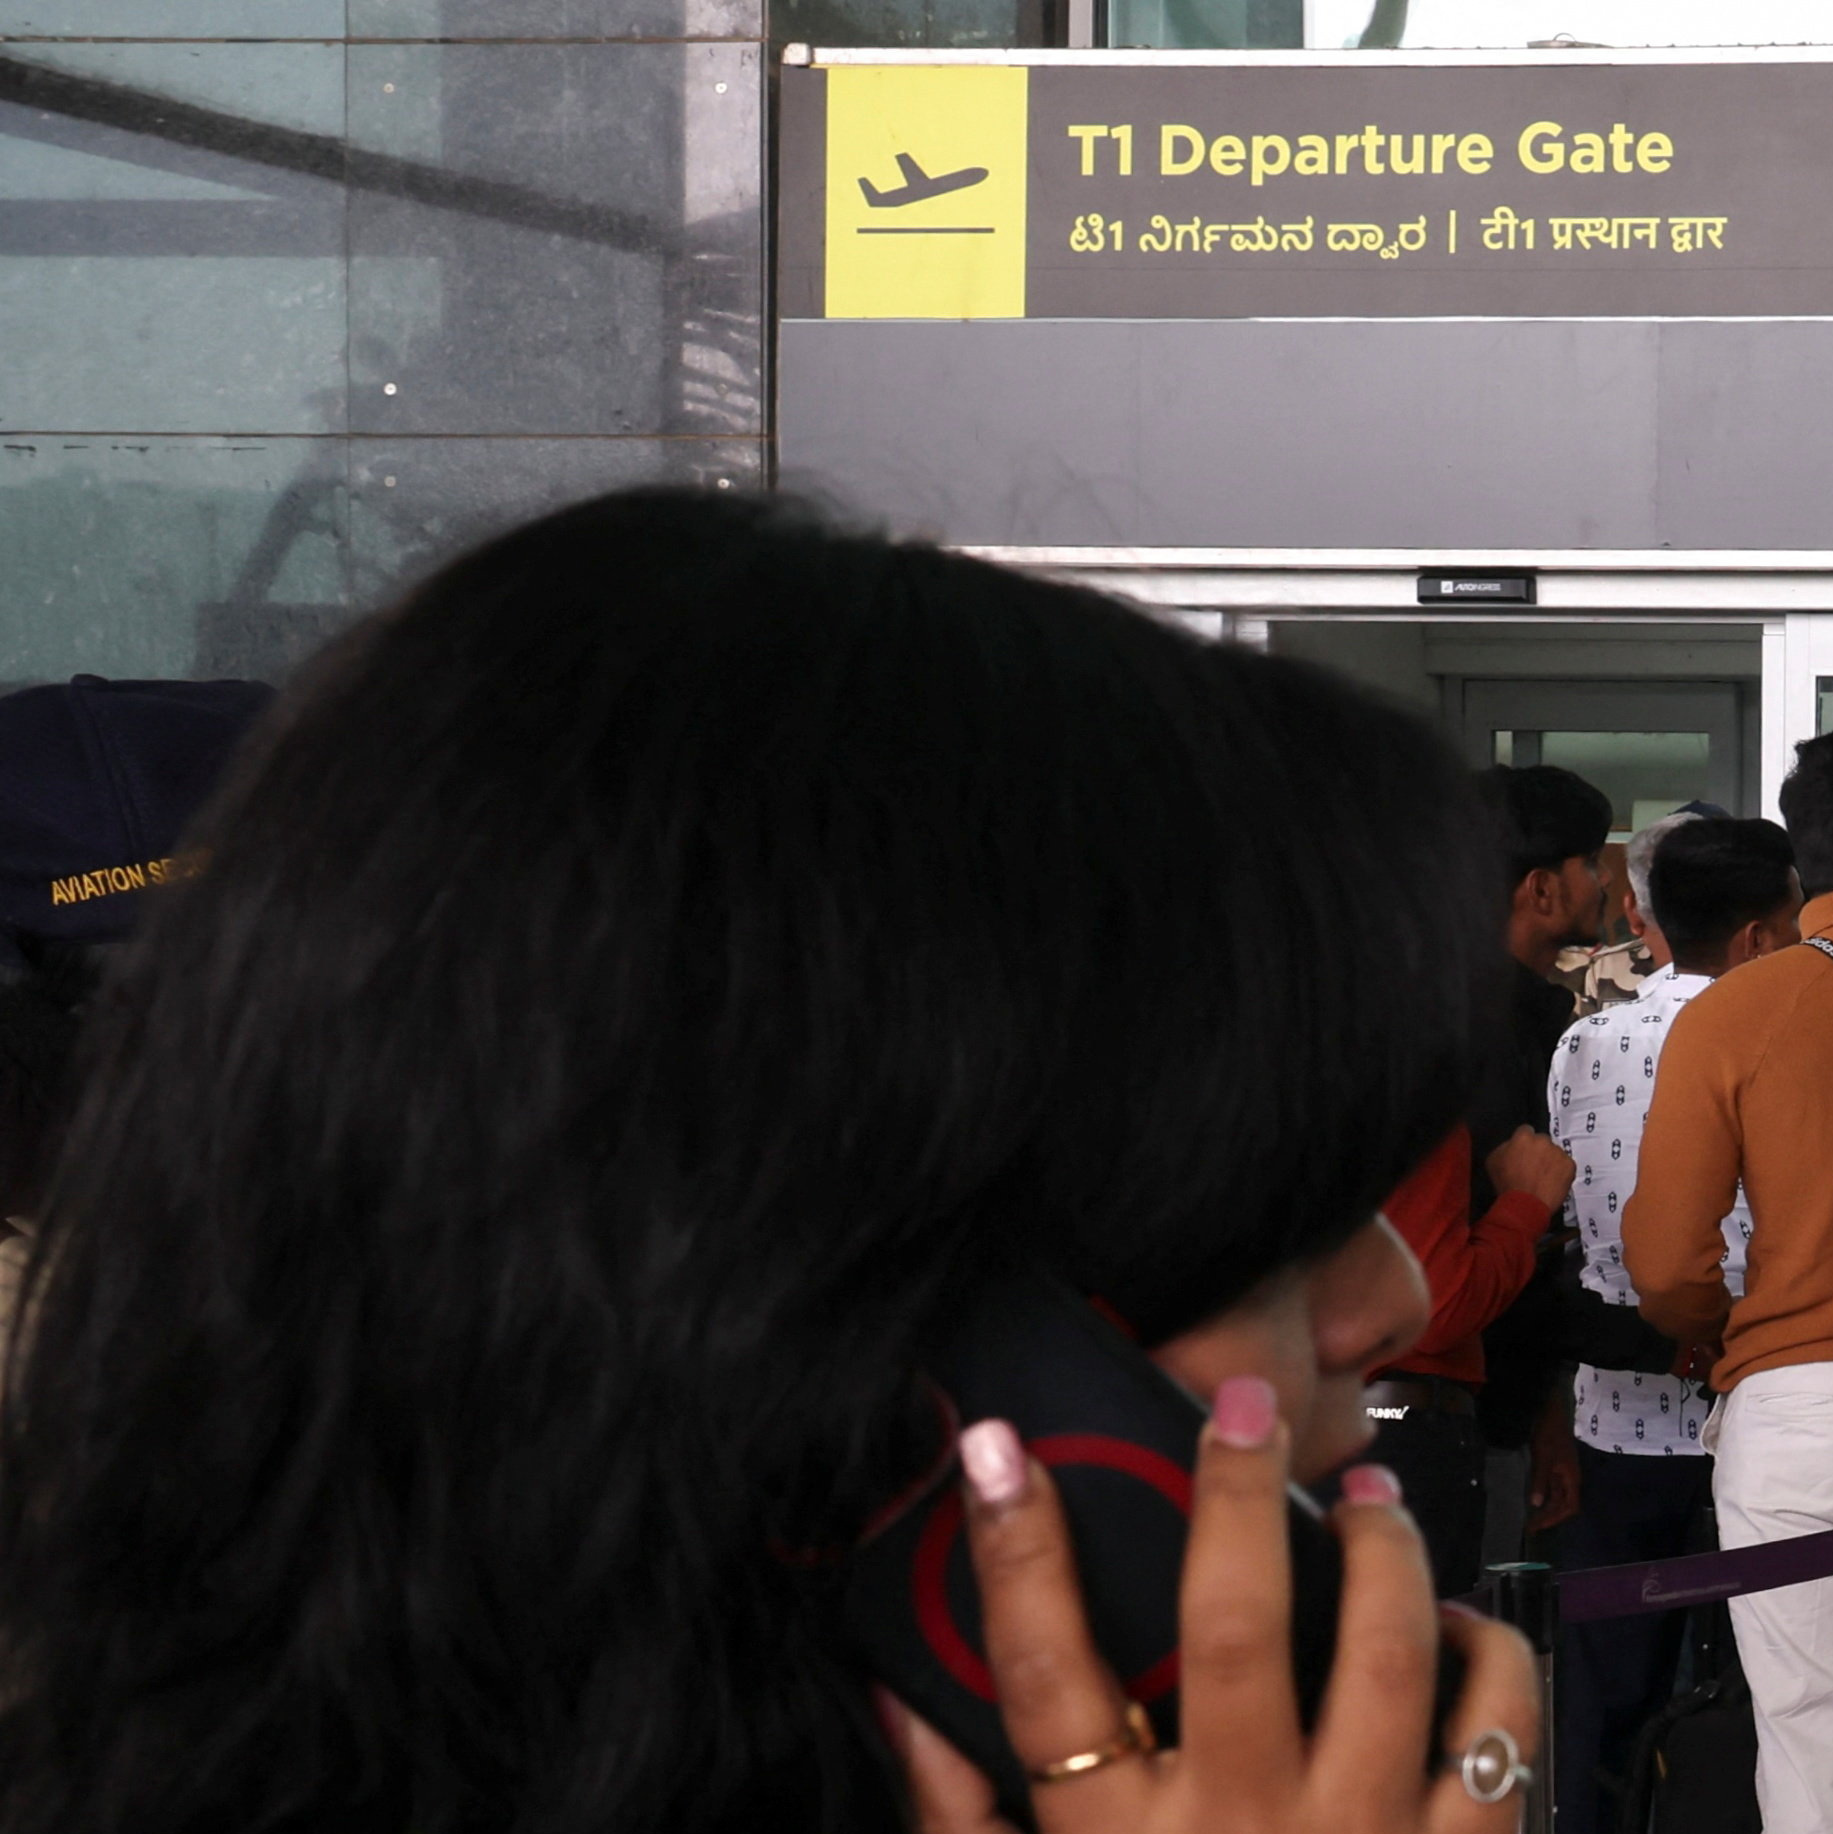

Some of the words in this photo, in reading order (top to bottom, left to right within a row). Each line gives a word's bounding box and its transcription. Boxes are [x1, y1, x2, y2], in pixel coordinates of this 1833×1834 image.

[1068, 125, 1131, 174] T1
[1161, 124, 1493, 186] Departure
[1518, 122, 1672, 173] Gate
[1138, 212, 1313, 253] ನಿರ್ಗಮನ
[1326, 214, 1426, 261] ದ್ವಾರ
[1551, 216, 1659, 251] प्रस्थान
[1670, 217, 1726, 253] द्वार
[51, 863, 146, 906] AVIATION
